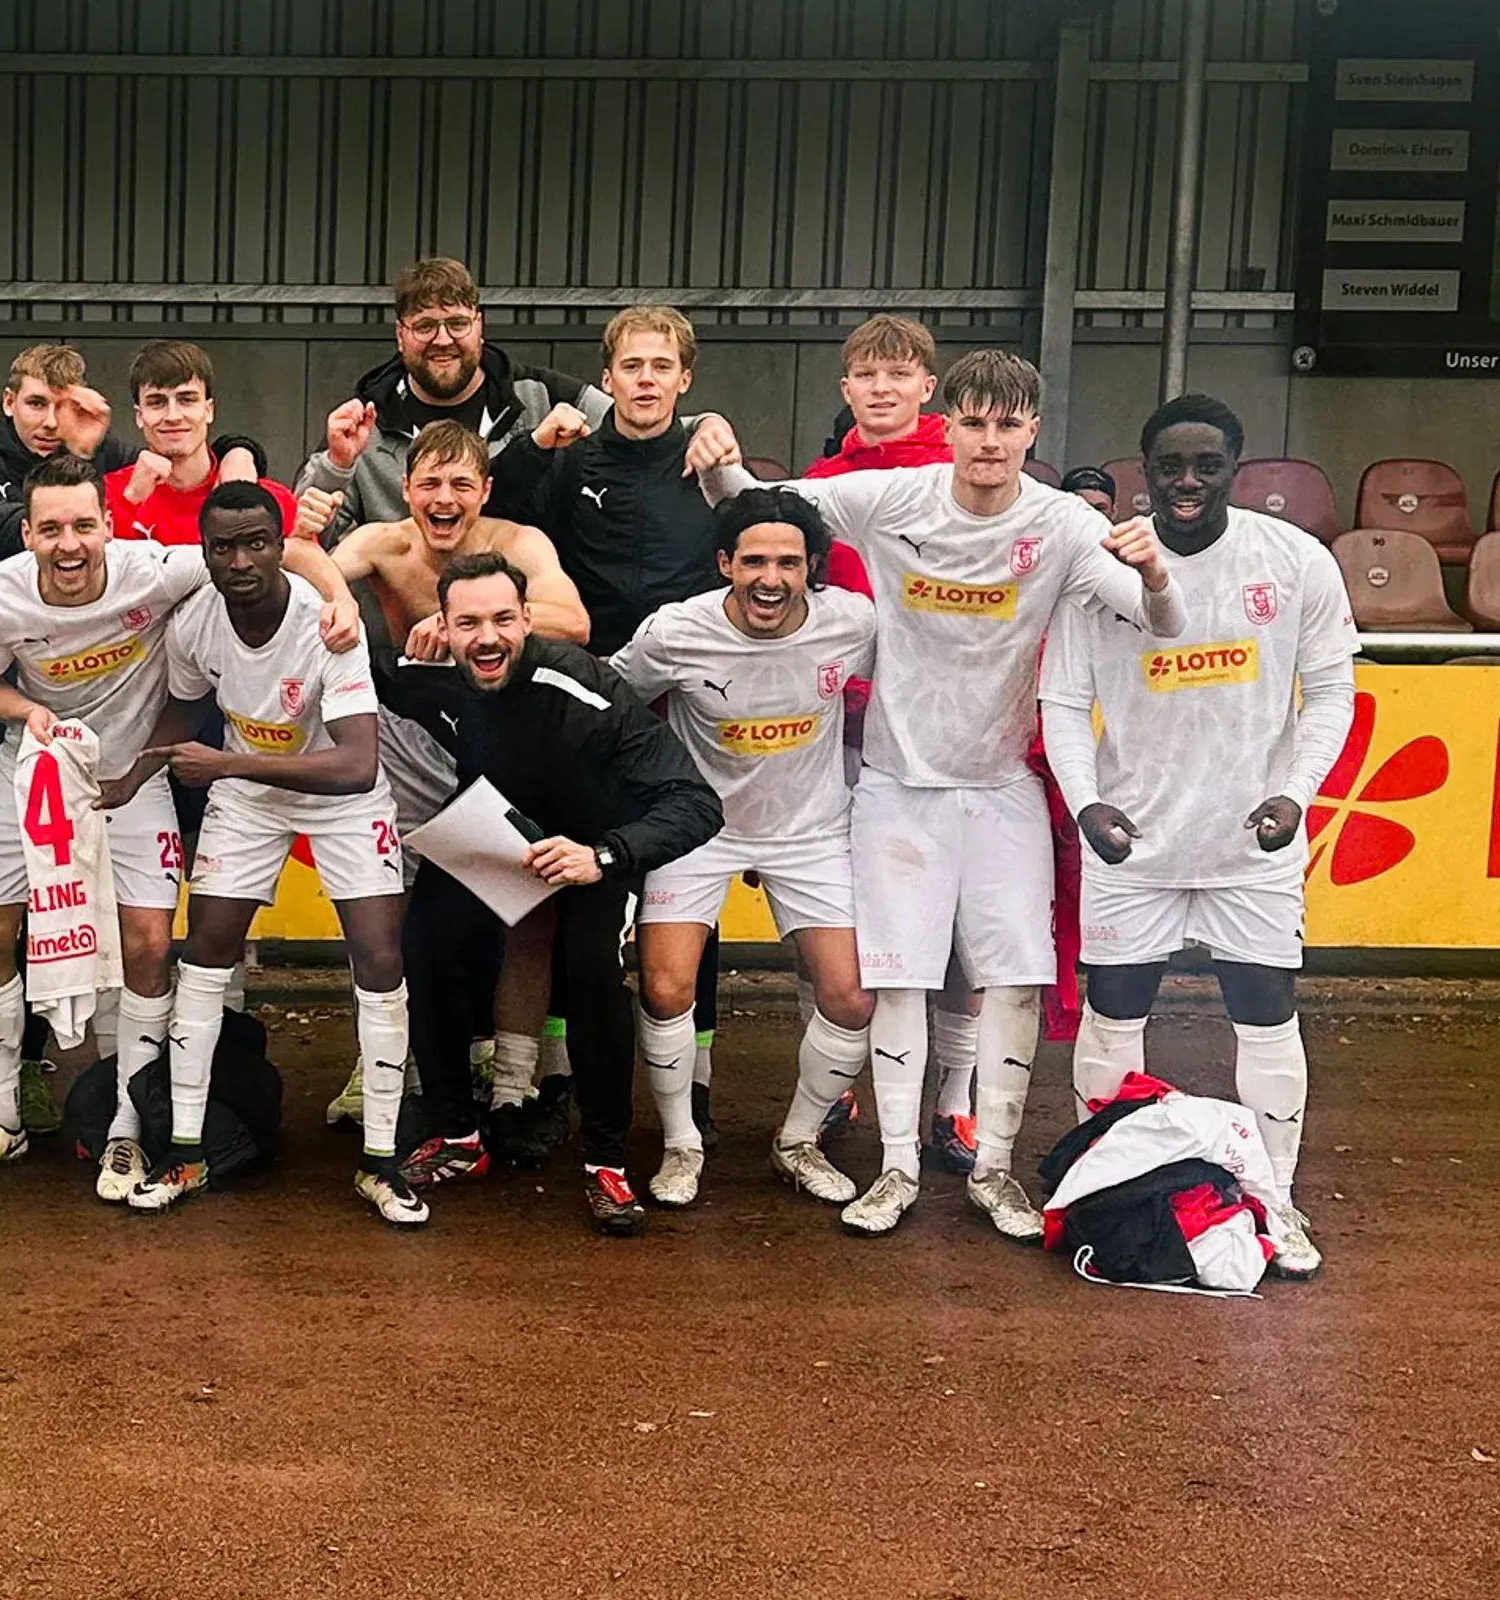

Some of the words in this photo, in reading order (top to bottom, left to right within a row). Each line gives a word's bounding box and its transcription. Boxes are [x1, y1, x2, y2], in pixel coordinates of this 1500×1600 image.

[1347, 73, 1381, 86] Sven
[1383, 73, 1463, 88] Steinhagen
[1349, 143, 1408, 156] Dominik
[1410, 143, 1453, 156] Ehlers
[1332, 214, 1366, 227] Maxi
[1368, 213, 1459, 228] Schmidbauer
[1341, 283, 1389, 297] Steven
[1391, 282, 1440, 297] Widdel
[1446, 351, 1499, 369] Unser
[935, 586, 1005, 604] LOTTO
[71, 645, 133, 673] LOTTO
[1176, 648, 1248, 673] LOTTO
[751, 720, 812, 741] LOTTO
[24, 750, 74, 867] 4
